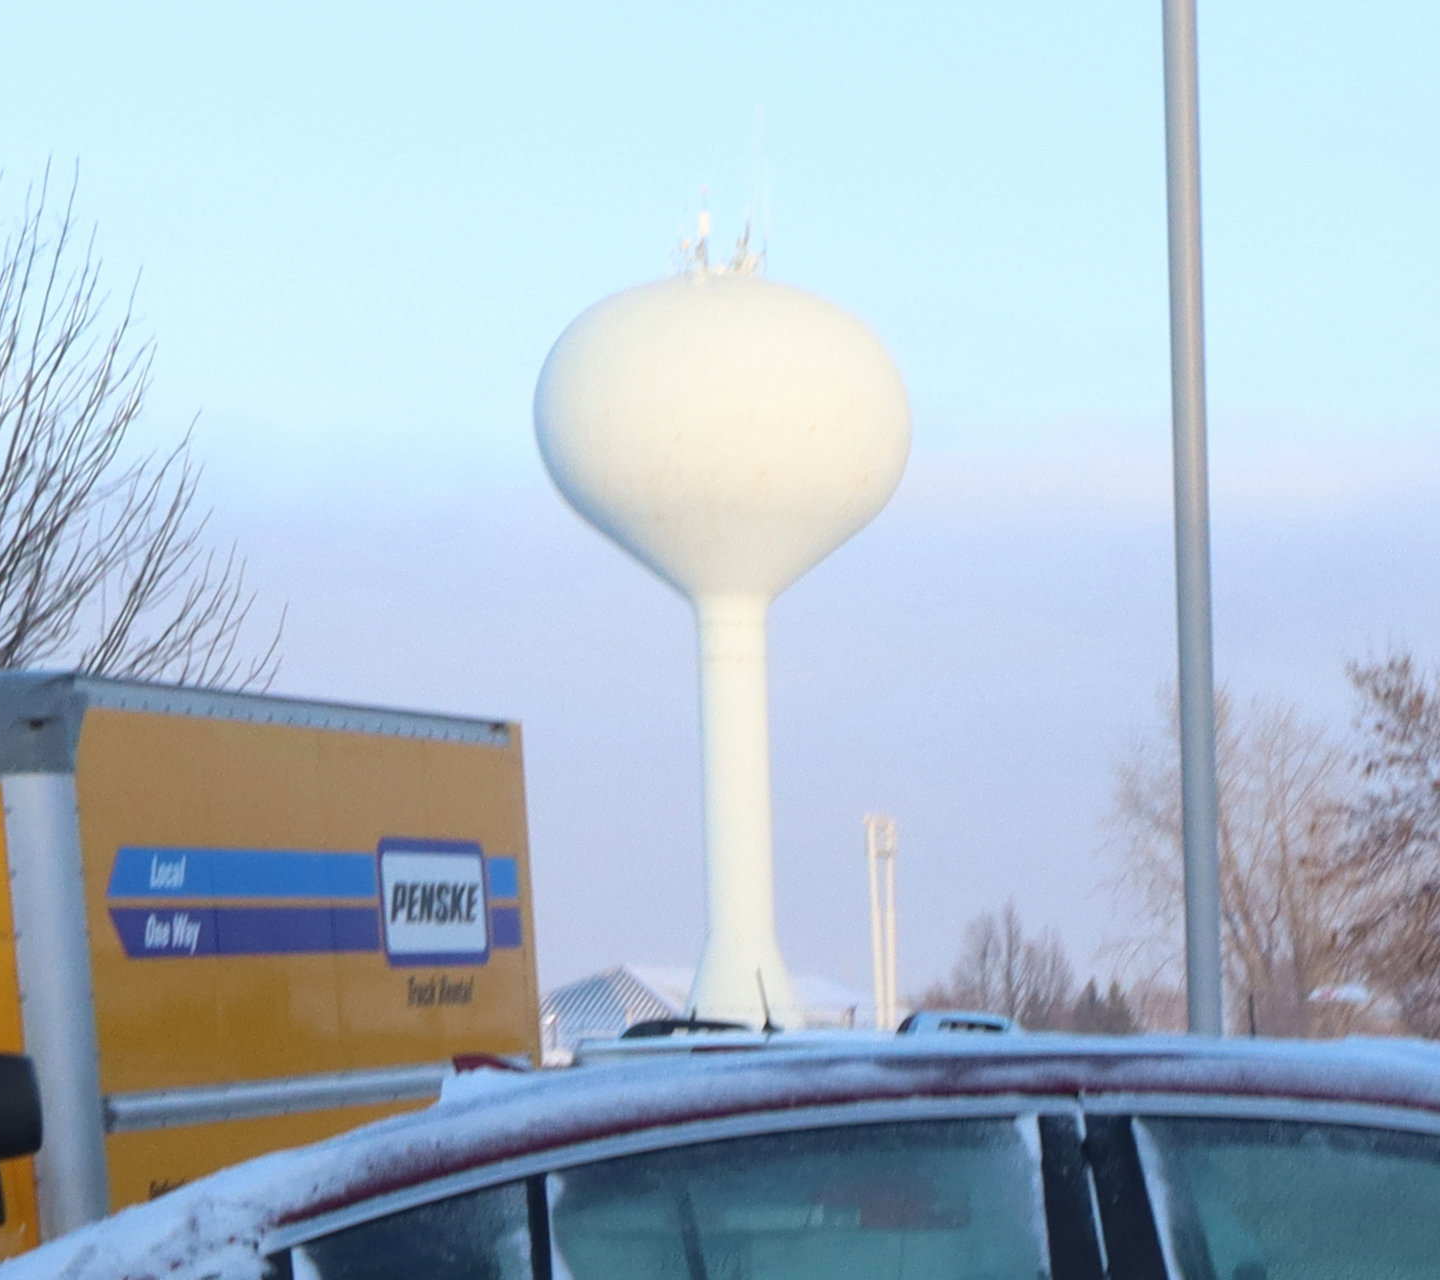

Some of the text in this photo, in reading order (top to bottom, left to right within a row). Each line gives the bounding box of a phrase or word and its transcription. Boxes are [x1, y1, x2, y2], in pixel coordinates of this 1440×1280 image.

[149, 854, 187, 889] Local
[390, 882, 479, 923] PENSKE
[144, 911, 201, 956] One Way
[407, 975, 475, 1007] Truck Rental
